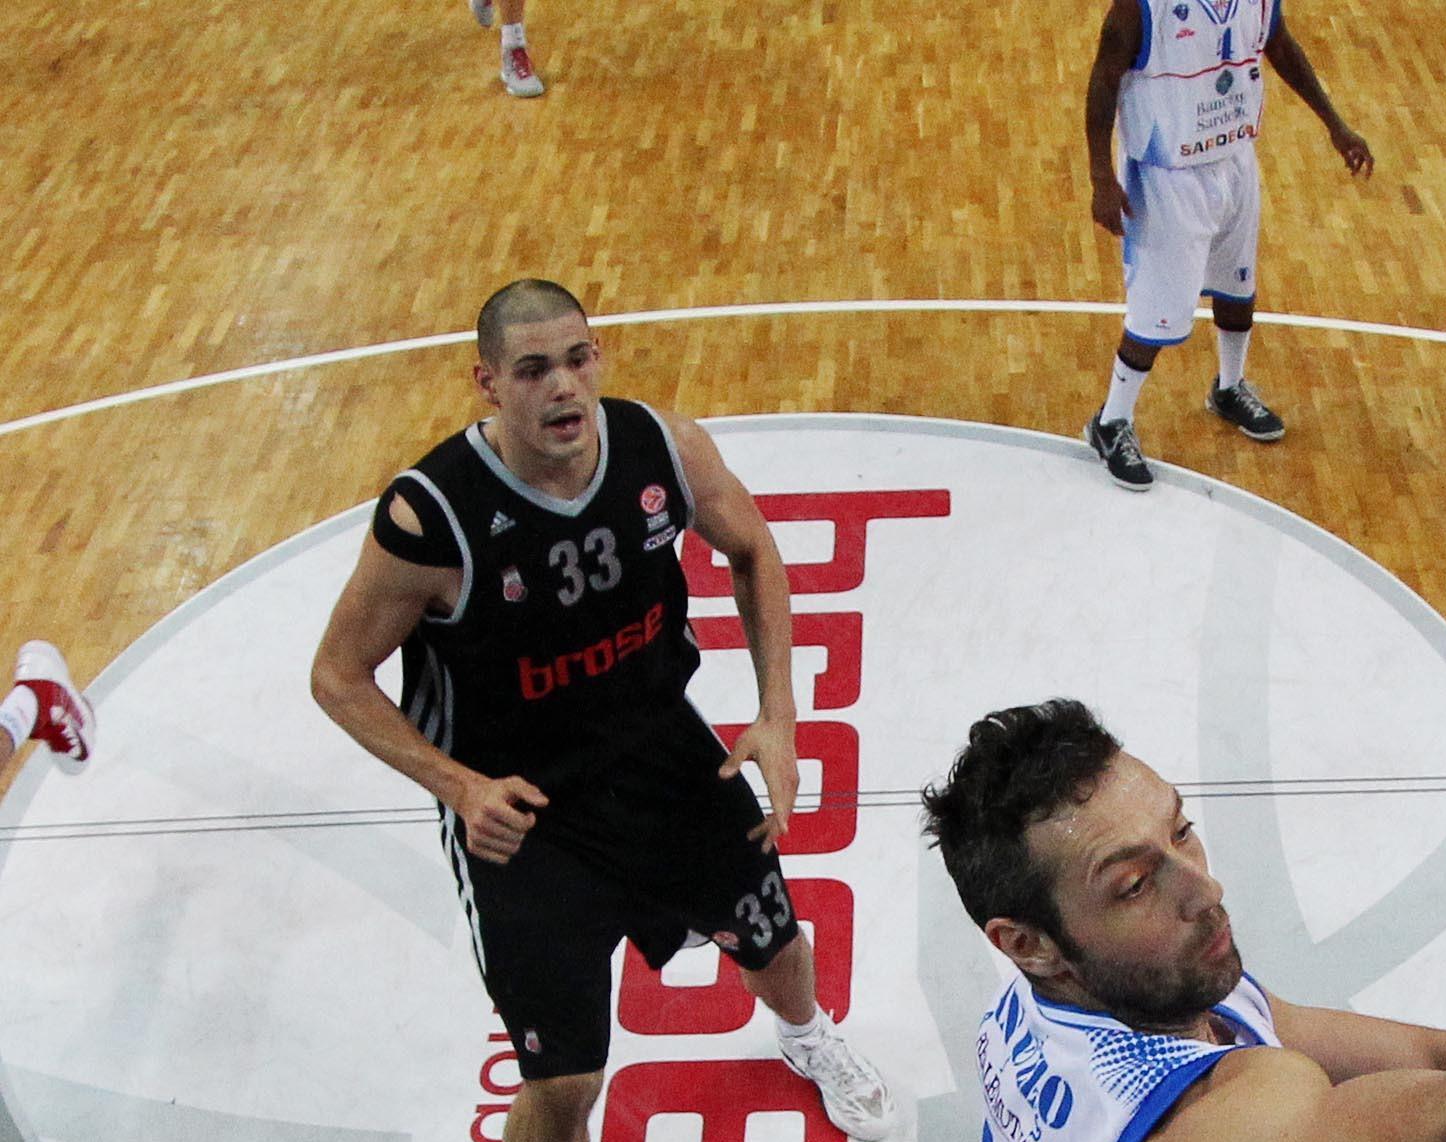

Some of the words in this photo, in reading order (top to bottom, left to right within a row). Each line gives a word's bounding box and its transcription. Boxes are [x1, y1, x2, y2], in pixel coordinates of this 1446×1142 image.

[547, 526, 623, 607] 33
[516, 600, 664, 702] brose
[734, 869, 790, 950] 33
